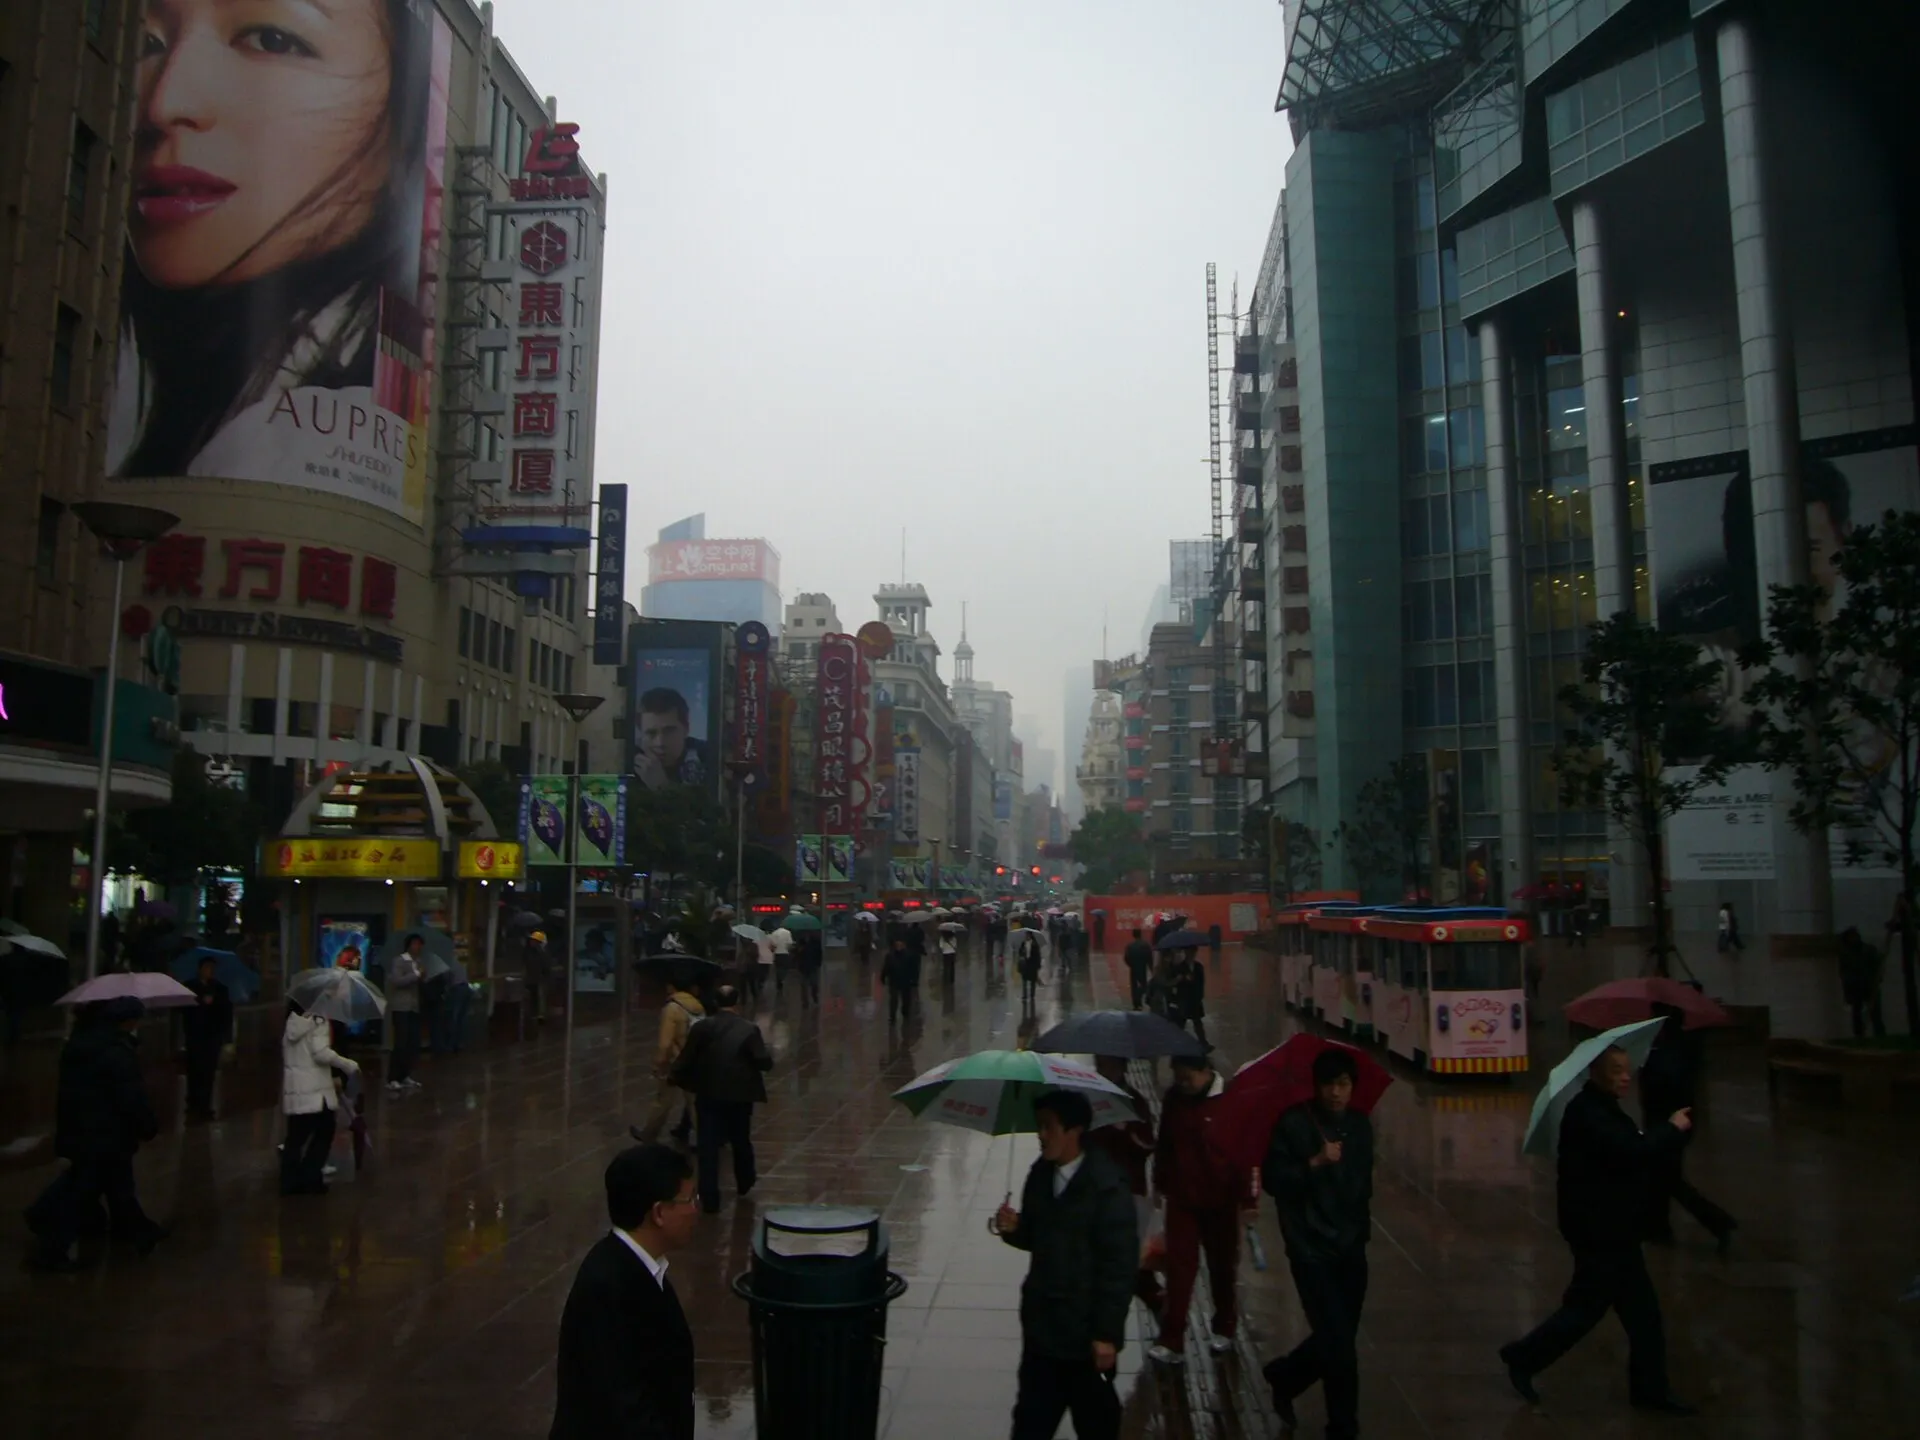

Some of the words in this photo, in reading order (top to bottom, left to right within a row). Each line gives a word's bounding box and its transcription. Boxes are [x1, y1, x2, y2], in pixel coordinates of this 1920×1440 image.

[266, 389, 419, 470] AUPRES
[704, 544, 757, 560] 空中网
